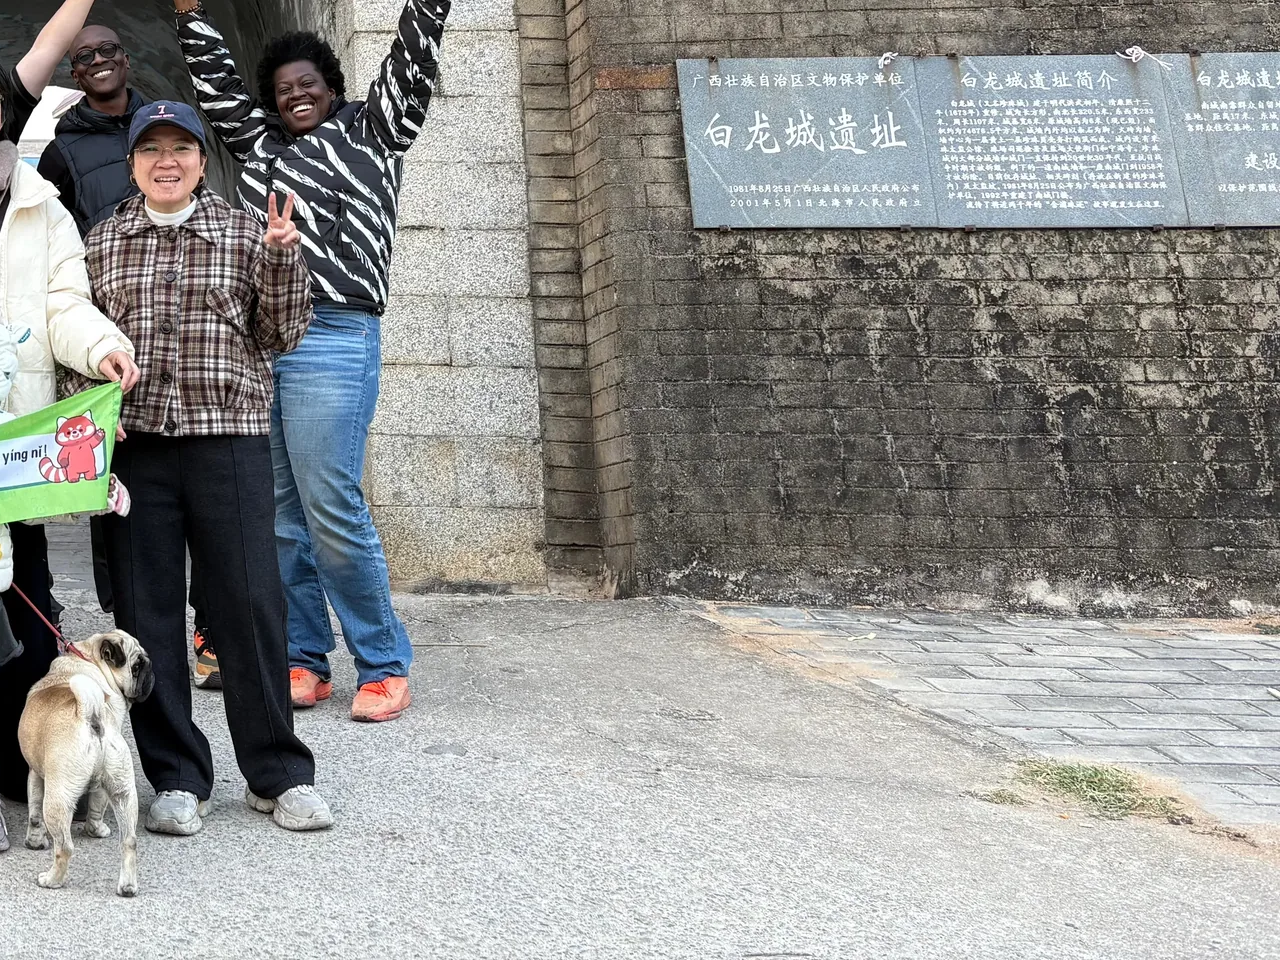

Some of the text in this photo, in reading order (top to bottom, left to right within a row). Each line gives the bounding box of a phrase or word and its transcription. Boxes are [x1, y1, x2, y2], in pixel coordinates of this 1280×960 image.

[692, 72, 905, 88] 广西壮族自治区文物保护单位
[960, 70, 1118, 90] 白龙城遗址简介
[1197, 68, 1280, 89] 白龙城遗
[704, 108, 907, 155] 白龙城遗址
[1244, 151, 1280, 171] 建设
[1218, 183, 1280, 193] 以保护范围线
[3, 447, 29, 466] yíng
